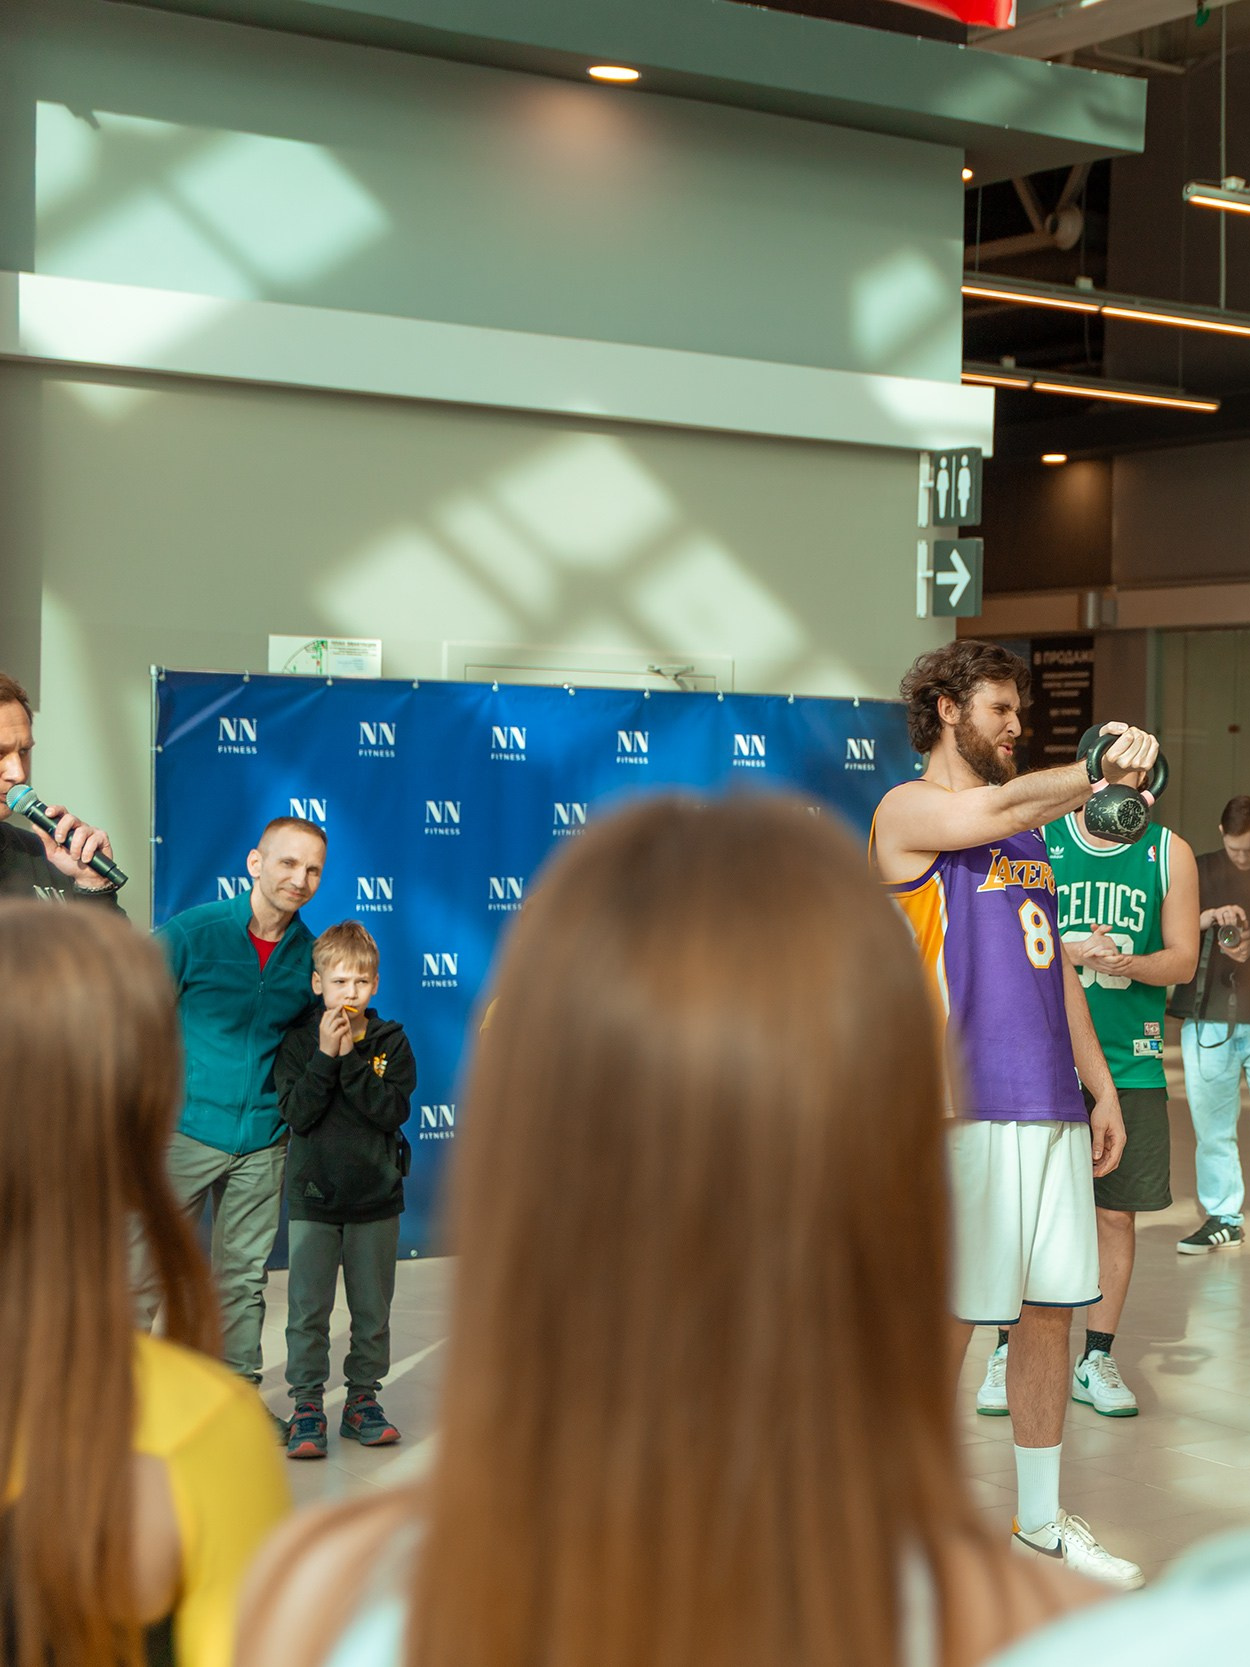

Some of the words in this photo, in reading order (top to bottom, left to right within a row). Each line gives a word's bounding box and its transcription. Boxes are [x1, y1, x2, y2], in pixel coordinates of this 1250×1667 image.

[219, 717, 257, 742] NN
[359, 721, 396, 746] NN
[491, 726, 527, 750] NN
[217, 745, 258, 754] FITNESS
[617, 730, 649, 753] NN
[733, 734, 766, 757] NN
[846, 738, 875, 760] NN
[358, 749, 396, 758] FITNESS
[490, 753, 527, 761] FITNESS
[616, 757, 649, 765] FITNESS
[732, 760, 766, 768] FITNESS
[844, 763, 876, 771] FITNESS
[290, 798, 327, 822] NN
[425, 800, 461, 824] NN
[553, 802, 588, 825] NN
[424, 827, 461, 836] FITNESS
[217, 877, 256, 901] NN
[357, 876, 394, 900] NN
[489, 876, 524, 900] NN
[356, 904, 394, 912] FITNESS
[488, 903, 523, 911] FITNESS
[1057, 881, 1147, 933] CELTICS
[1018, 898, 1056, 969] 8
[424, 952, 458, 976] NN
[422, 980, 458, 988] FITNESS
[420, 1104, 456, 1128] NN
[419, 1131, 455, 1140] FITNESS
